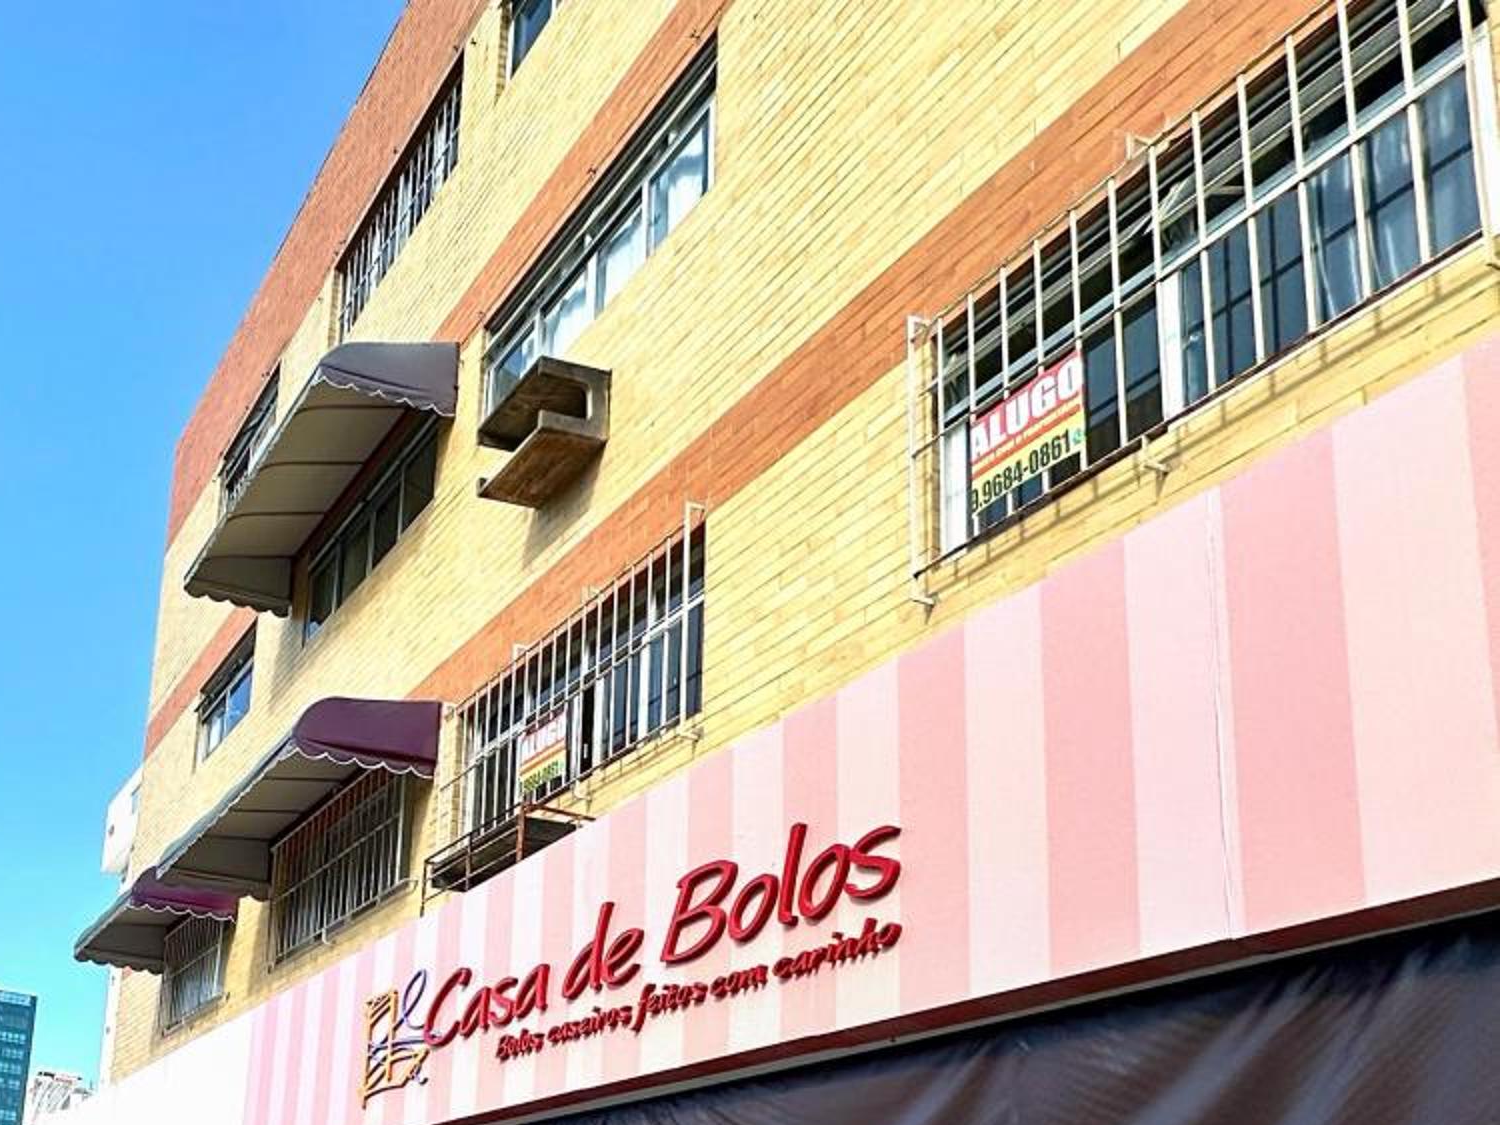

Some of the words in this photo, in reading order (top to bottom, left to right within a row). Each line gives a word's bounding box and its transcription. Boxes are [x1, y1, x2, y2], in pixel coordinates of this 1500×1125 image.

[971, 356, 1083, 463] ALUGO
[424, 963, 551, 1047] Casa
[562, 901, 645, 1001] de
[660, 822, 903, 965] Bolos
[496, 1028, 545, 1062] Bolos
[547, 1006, 633, 1045] caseiros
[631, 983, 709, 1034] feitos
[710, 964, 769, 1000] com
[772, 917, 903, 982] carinho
